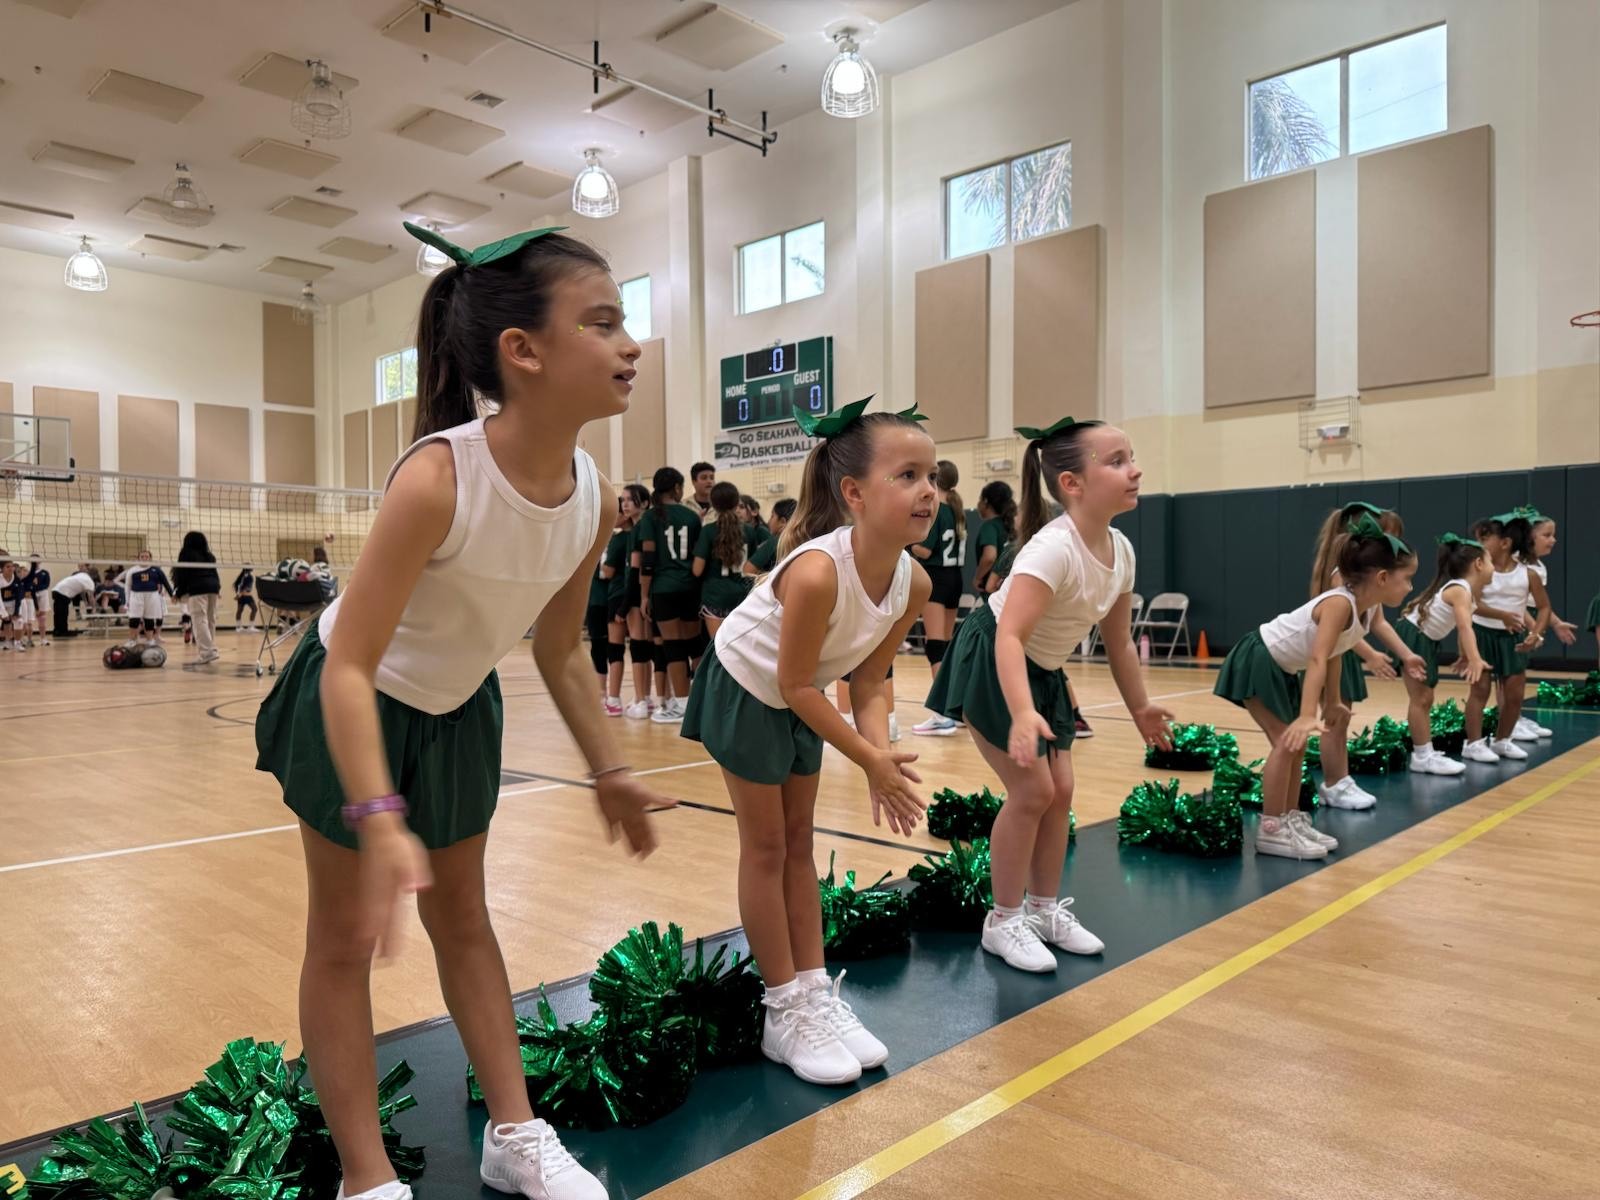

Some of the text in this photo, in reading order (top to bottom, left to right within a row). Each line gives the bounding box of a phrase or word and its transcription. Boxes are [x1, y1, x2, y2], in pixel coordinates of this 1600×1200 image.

[794, 369, 821, 386] GUEST
[725, 384, 747, 398] HOME
[760, 384, 781, 395] PERIOD
[810, 384, 822, 410] 0
[738, 398, 749, 422] 0
[756, 427, 804, 442] SEAHAW
[742, 440, 812, 459] BASKETBALL
[664, 525, 688, 560] 11
[942, 528, 968, 567] 21
